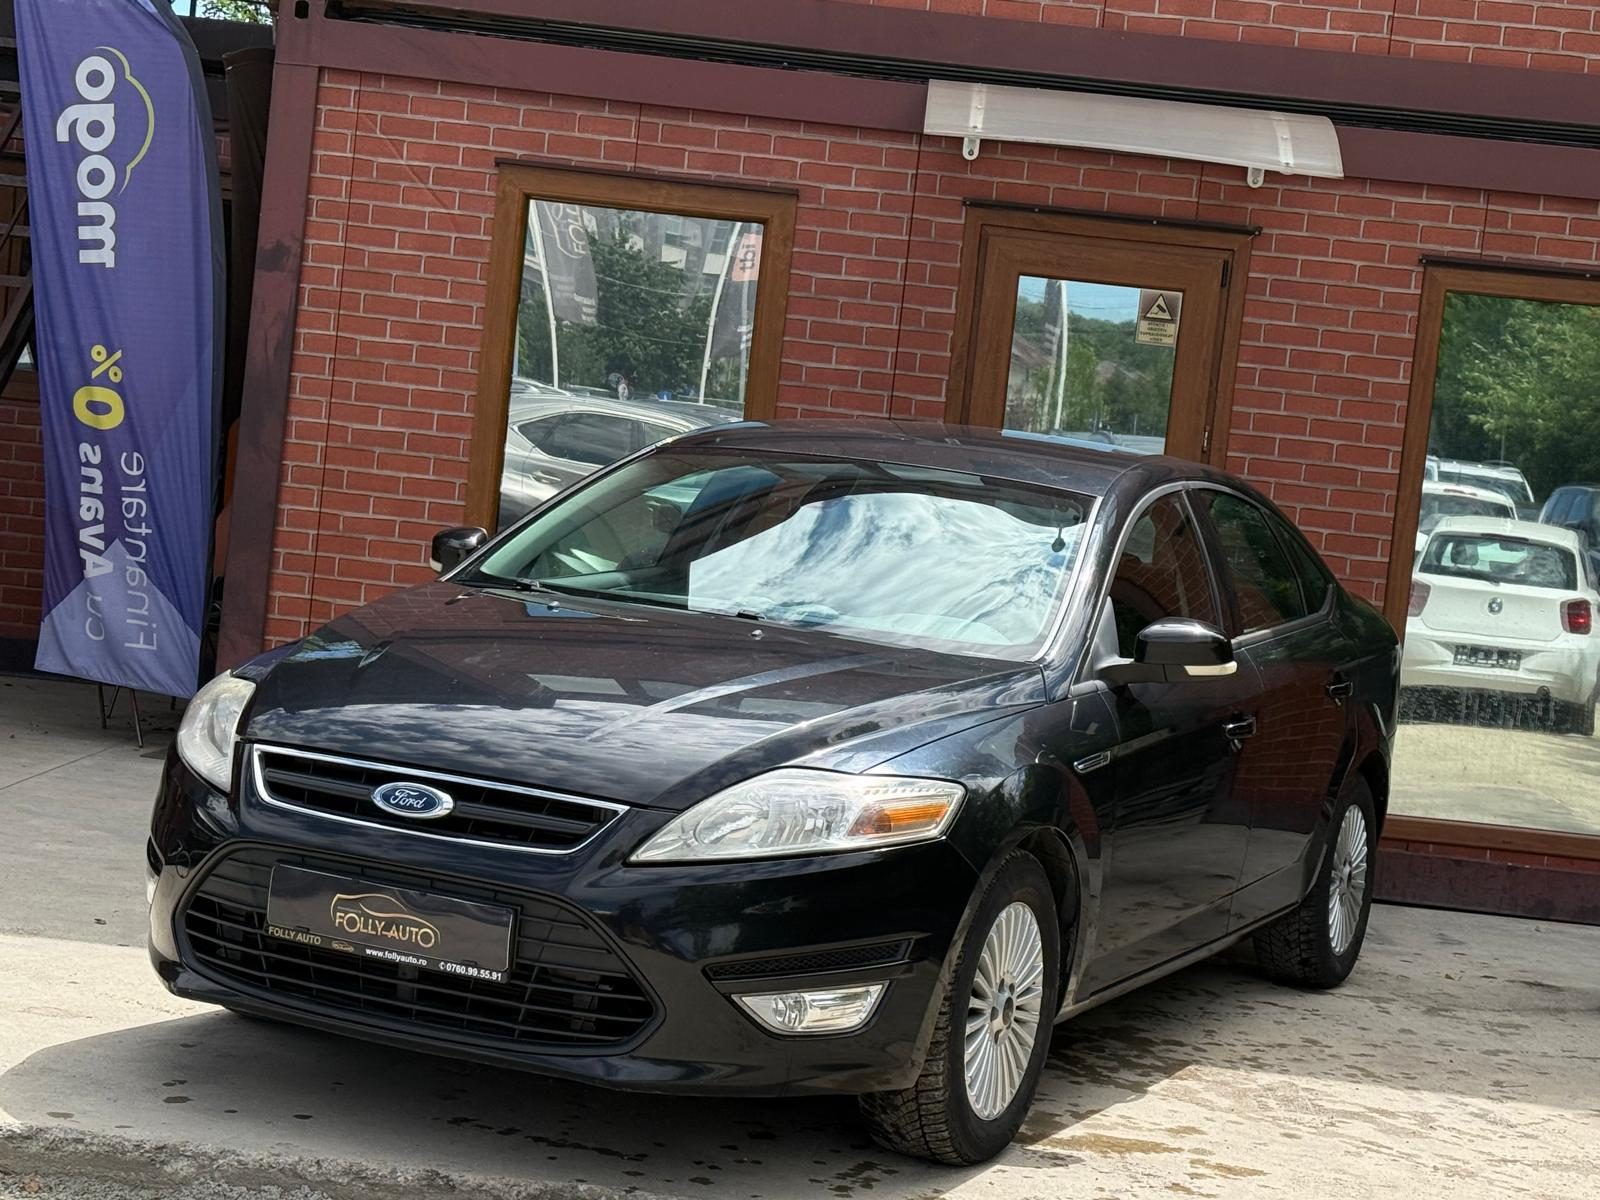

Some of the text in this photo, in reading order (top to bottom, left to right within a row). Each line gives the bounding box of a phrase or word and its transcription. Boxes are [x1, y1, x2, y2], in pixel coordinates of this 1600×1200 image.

[390, 789, 427, 808] Ford
[268, 926, 322, 945] FOLLY AUTO
[335, 911, 435, 948] FOLLY AUTO
[365, 948, 427, 966] www.follyauto.ro
